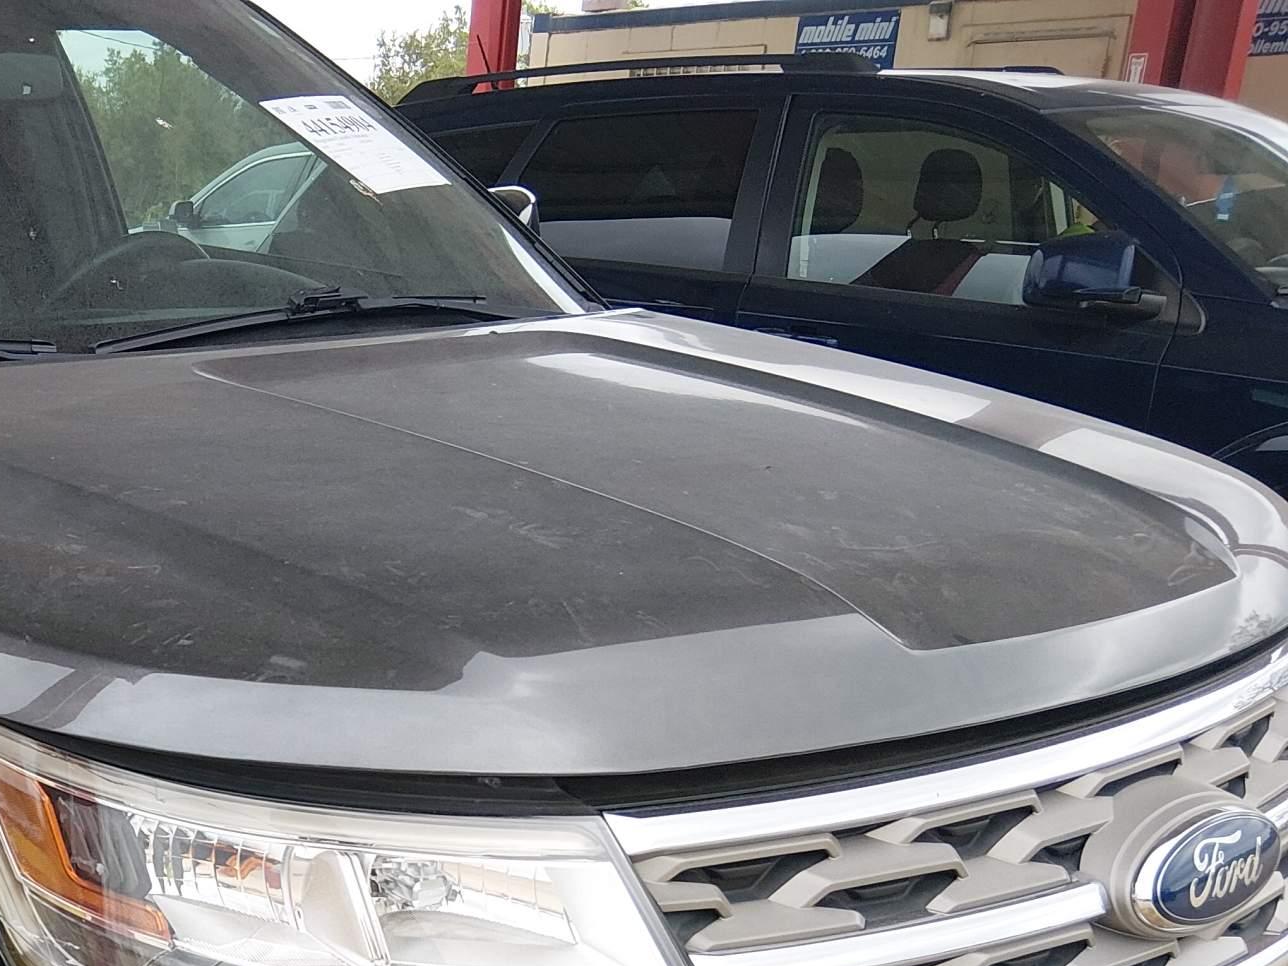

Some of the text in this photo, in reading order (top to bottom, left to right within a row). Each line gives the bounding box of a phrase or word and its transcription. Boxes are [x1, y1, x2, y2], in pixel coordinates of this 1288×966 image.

[799, 16, 899, 43] mobile mini
[302, 115, 377, 136] 44154904
[1190, 830, 1262, 908] Ford
